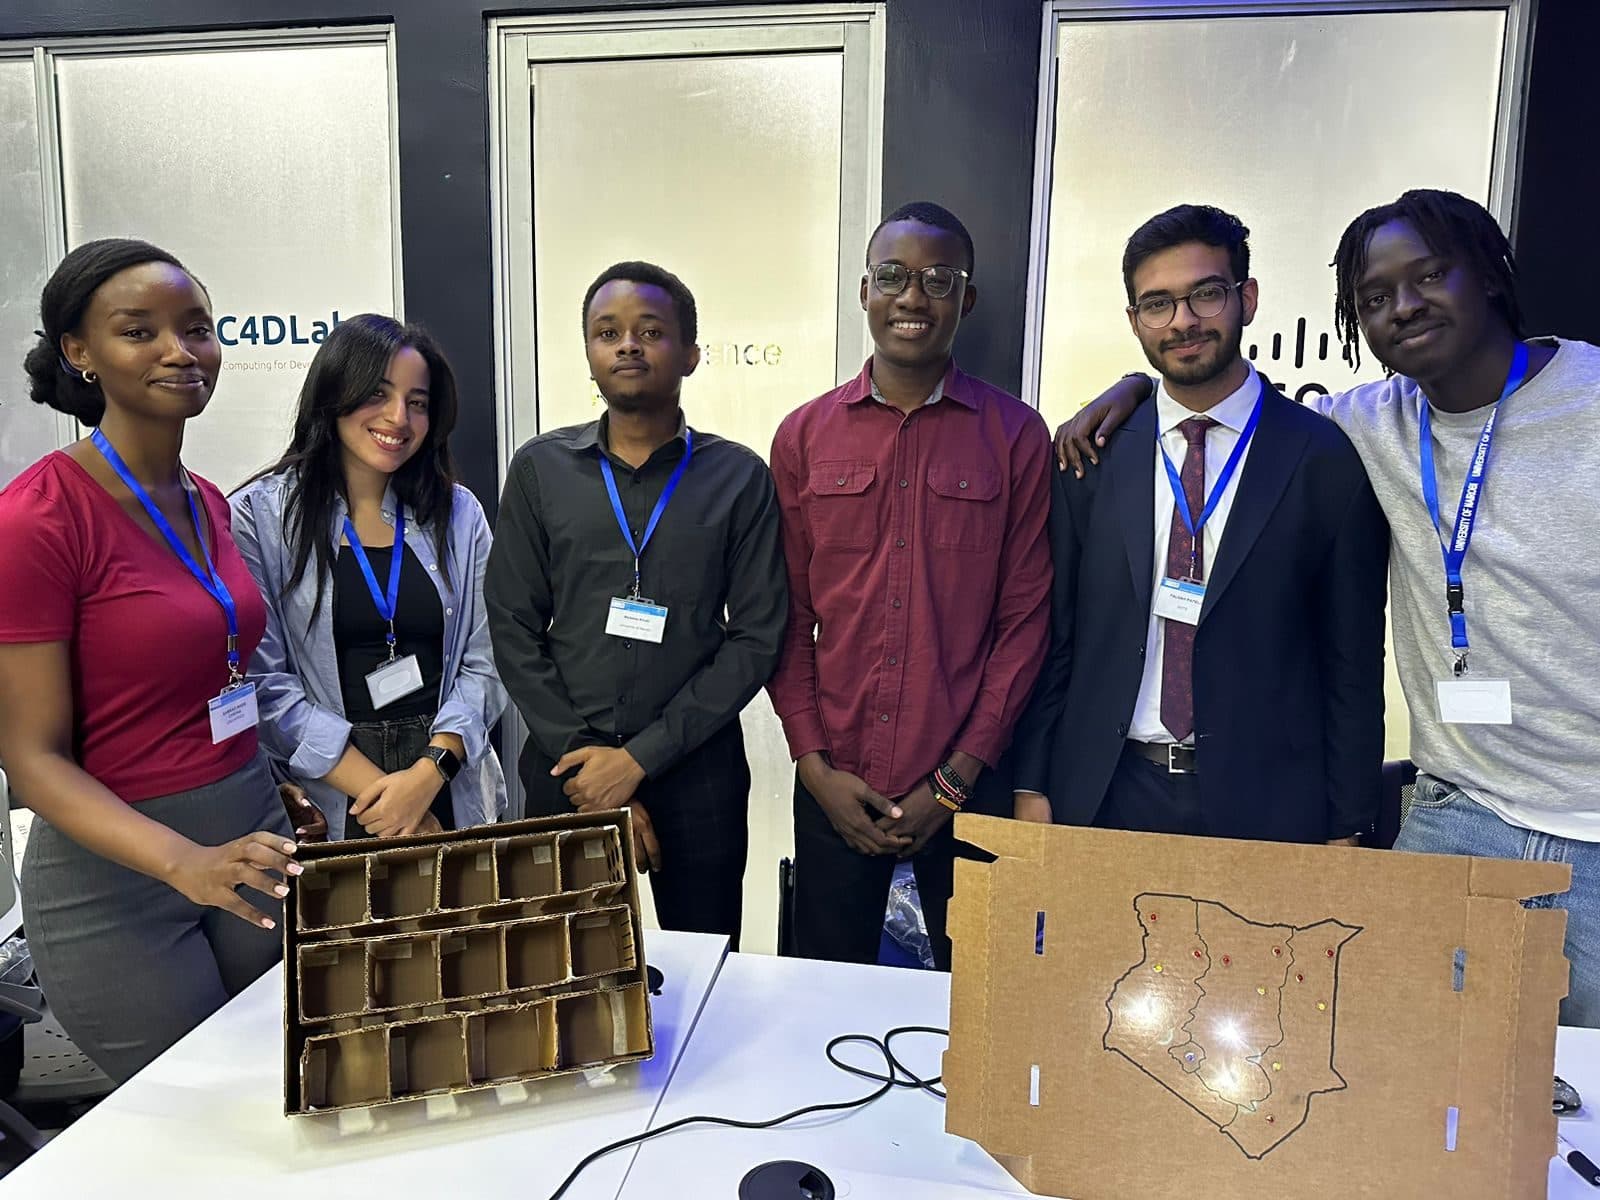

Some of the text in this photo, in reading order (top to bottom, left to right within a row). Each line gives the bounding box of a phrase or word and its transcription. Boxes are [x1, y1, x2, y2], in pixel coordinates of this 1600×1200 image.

[223, 360, 272, 372] Computing
[274, 359, 287, 369] for
[1471, 442, 1489, 477] UNIVERSITY
[1454, 482, 1479, 552] UNIVERSITY OF NAIROBI
